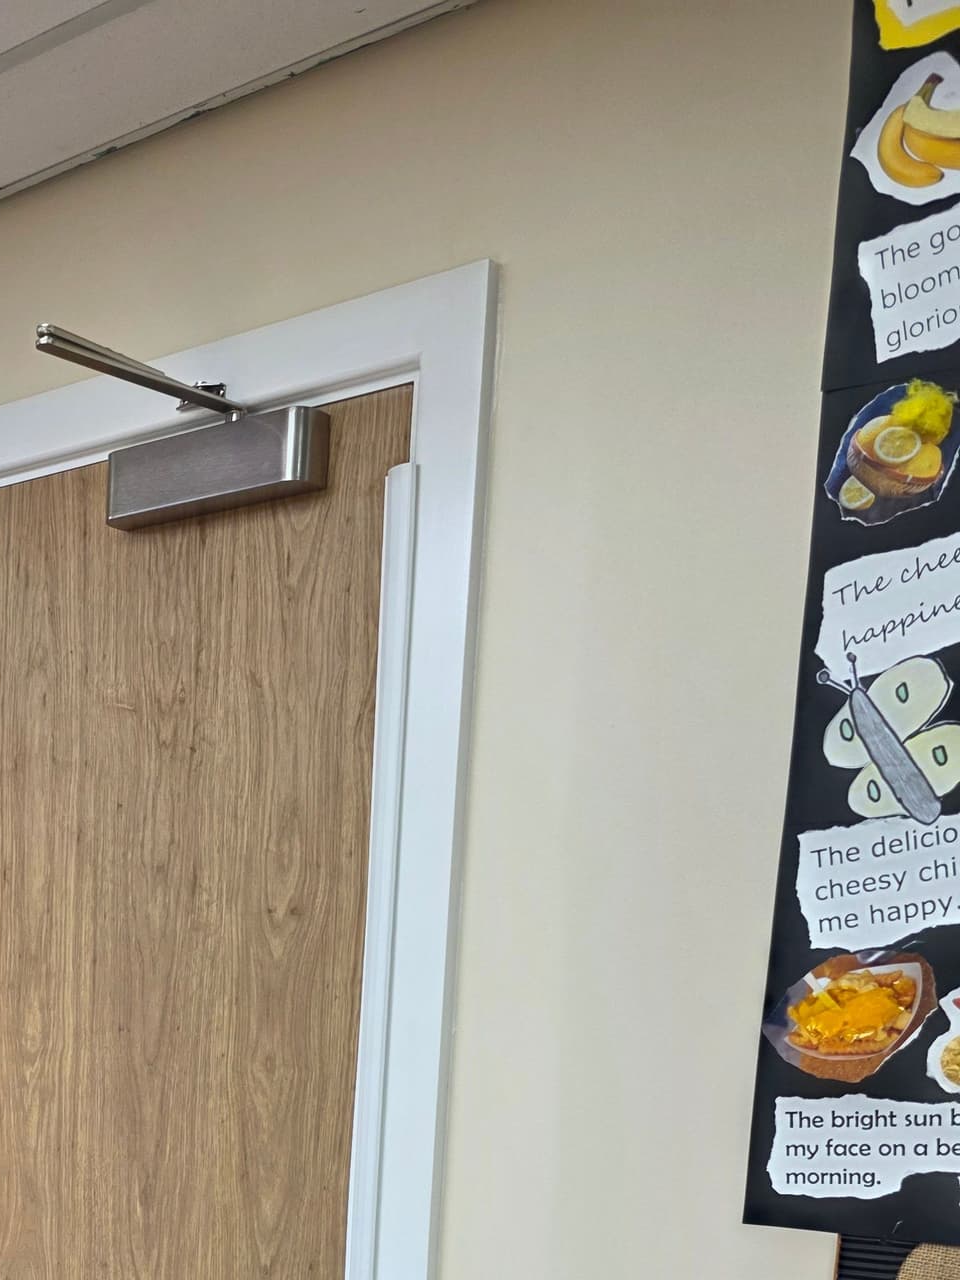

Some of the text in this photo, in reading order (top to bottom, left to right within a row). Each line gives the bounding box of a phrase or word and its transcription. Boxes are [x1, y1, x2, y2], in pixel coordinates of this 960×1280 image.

[874, 241, 921, 270] The
[881, 265, 960, 309] bloom
[886, 304, 960, 353] glorio
[832, 575, 893, 606] The
[810, 825, 958, 868] The delicio
[815, 856, 957, 901] cheesy chi
[819, 912, 859, 933] me
[785, 1111, 825, 1128] The
[831, 1109, 897, 1130] bright
[904, 1113, 942, 1127] sun
[785, 1143, 819, 1160] my
[825, 1138, 871, 1157] face
[878, 1143, 906, 1157] on
[913, 1143, 928, 1157] a
[785, 1168, 881, 1188] morning.
